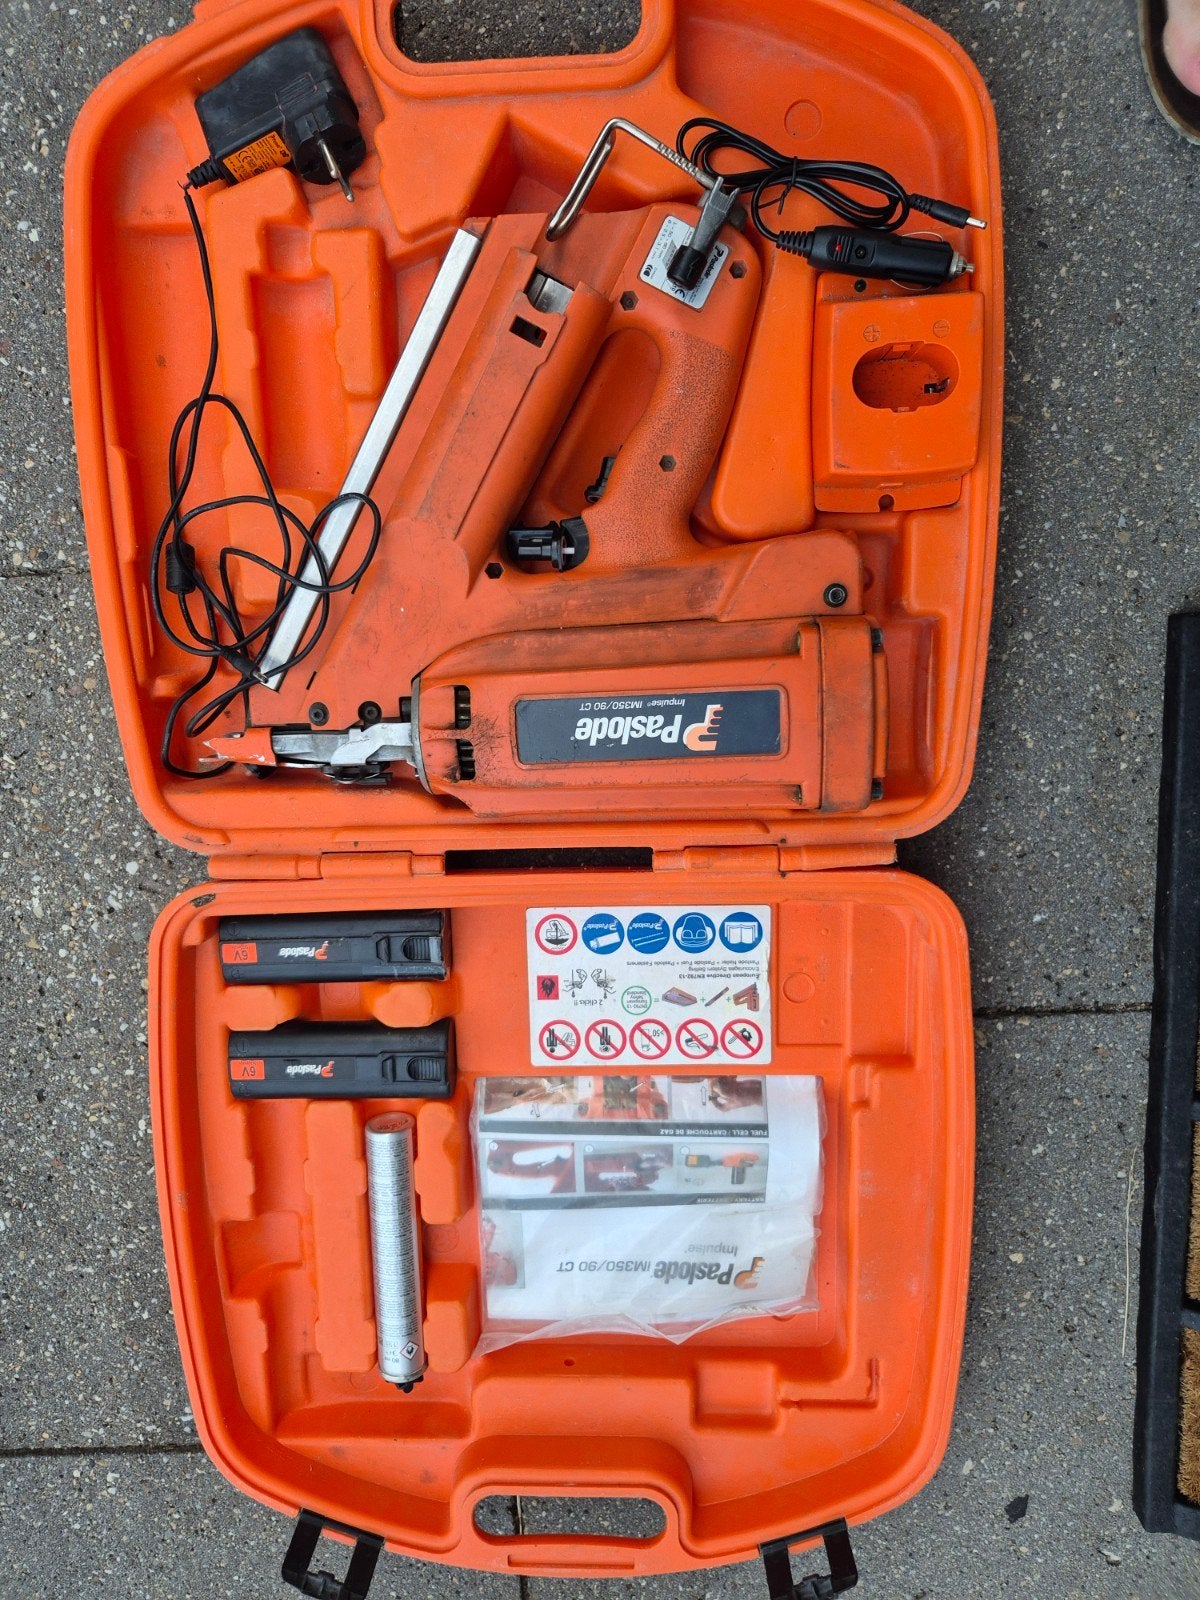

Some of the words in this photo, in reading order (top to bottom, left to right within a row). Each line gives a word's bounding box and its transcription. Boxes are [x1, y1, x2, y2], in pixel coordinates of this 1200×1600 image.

[703, 254, 718, 279] Paslode
[580, 702, 592, 710] CT
[594, 700, 642, 710] IM350/90
[234, 950, 248, 960] 6V
[278, 946, 315, 958] Paslode
[242, 1066, 256, 1076] 6V
[286, 1064, 322, 1074] Paslode
[556, 1261, 574, 1272] CT
[578, 1260, 651, 1272] IM350/90
[653, 1260, 734, 1285] Paslode
